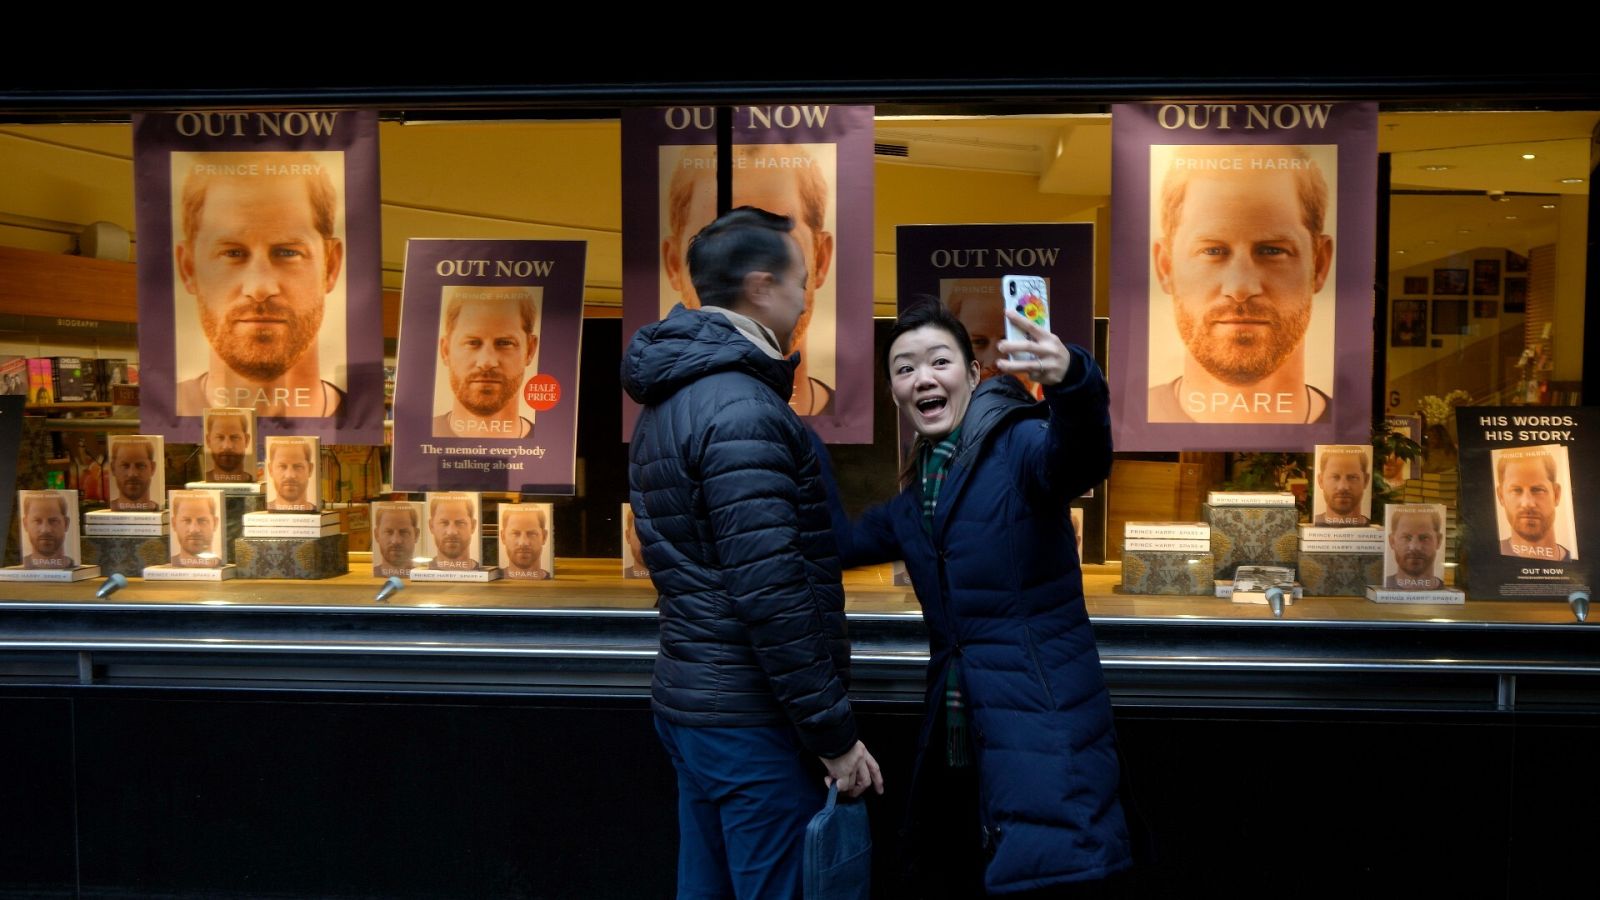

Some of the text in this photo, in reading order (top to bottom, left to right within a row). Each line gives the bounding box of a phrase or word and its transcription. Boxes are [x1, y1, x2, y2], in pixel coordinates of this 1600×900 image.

[664, 105, 830, 129] OU NOW
[1158, 104, 1333, 129] OUT NOW
[176, 112, 338, 136] OUT NOW
[683, 157, 813, 169] PRIE HARRY
[1175, 158, 1312, 170] PRINCE HARRY
[194, 164, 321, 175] PRINCE HARRY
[930, 248, 1060, 268] OUT NOW
[436, 259, 555, 278] OUT NOW
[455, 292, 530, 300] PRINCE HARRY
[955, 286, 995, 294] PRINCE
[529, 383, 557, 391] HALF
[214, 387, 311, 408] SPARE
[527, 393, 557, 402] PRICE
[1188, 392, 1294, 413] SPARE
[454, 420, 513, 433] SPARE
[1480, 416, 1578, 426] HIS WORDS.
[1485, 430, 1575, 441] HIS STORY.
[420, 444, 546, 459] The memoir everybody
[442, 459, 524, 473] is talking about
[1325, 517, 1358, 525] SPARE
[1512, 544, 1554, 557] SPARE
[437, 561, 468, 569] SPARE
[508, 570, 538, 578] SPARE
[1397, 578, 1431, 586] SPARE
